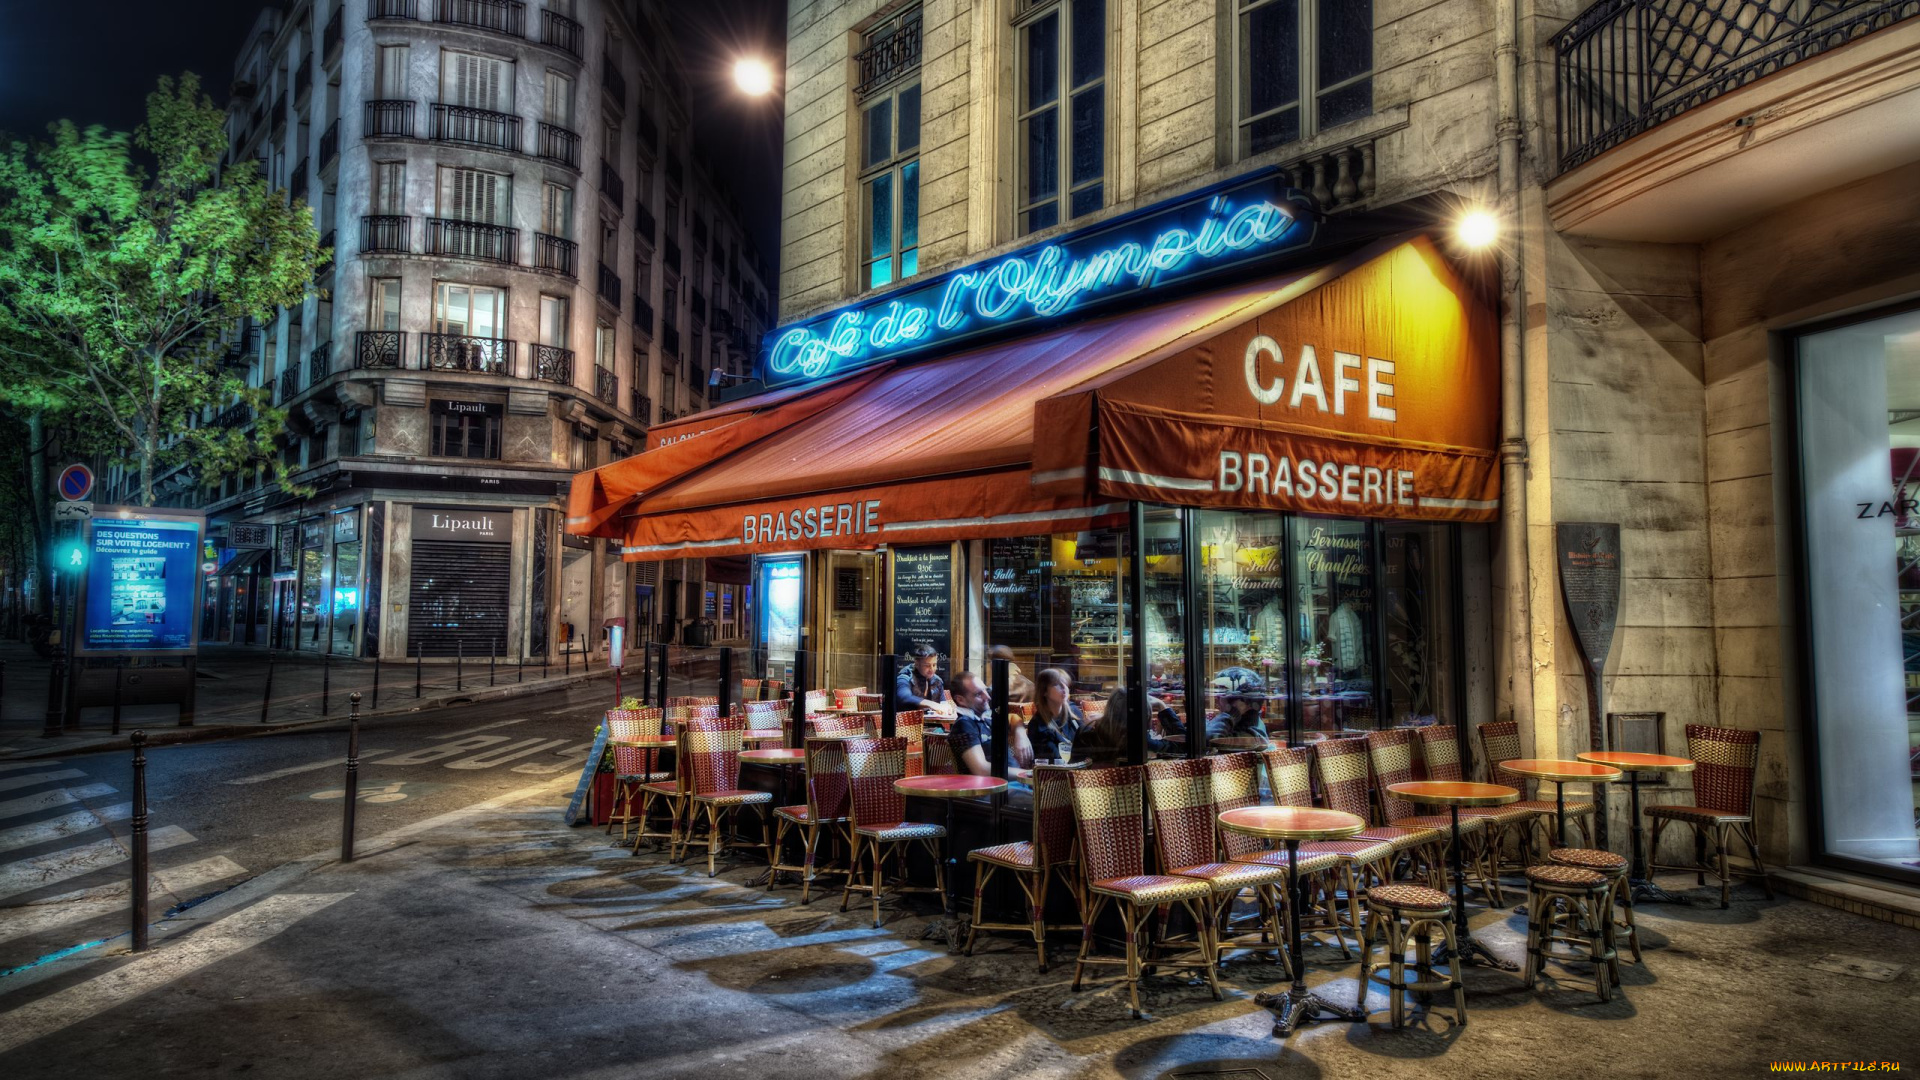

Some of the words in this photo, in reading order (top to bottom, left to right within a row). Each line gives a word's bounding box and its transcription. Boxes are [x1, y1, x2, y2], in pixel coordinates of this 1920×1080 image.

[770, 311, 866, 378] Café
[870, 300, 928, 350] de
[1244, 335, 1397, 422] CAFE
[448, 401, 486, 413] Lipault
[1219, 450, 1415, 507] BRASSERIE
[432, 514, 494, 532] Lipault
[743, 500, 881, 545] BRASSERIE
[96, 539, 113, 547] SUR
[114, 540, 141, 548] VOTRE
[142, 541, 184, 549] LOGEMENT
[97, 530, 113, 538] DES
[114, 532, 159, 540] QUESTIONS
[1309, 527, 1361, 550] Terrasse
